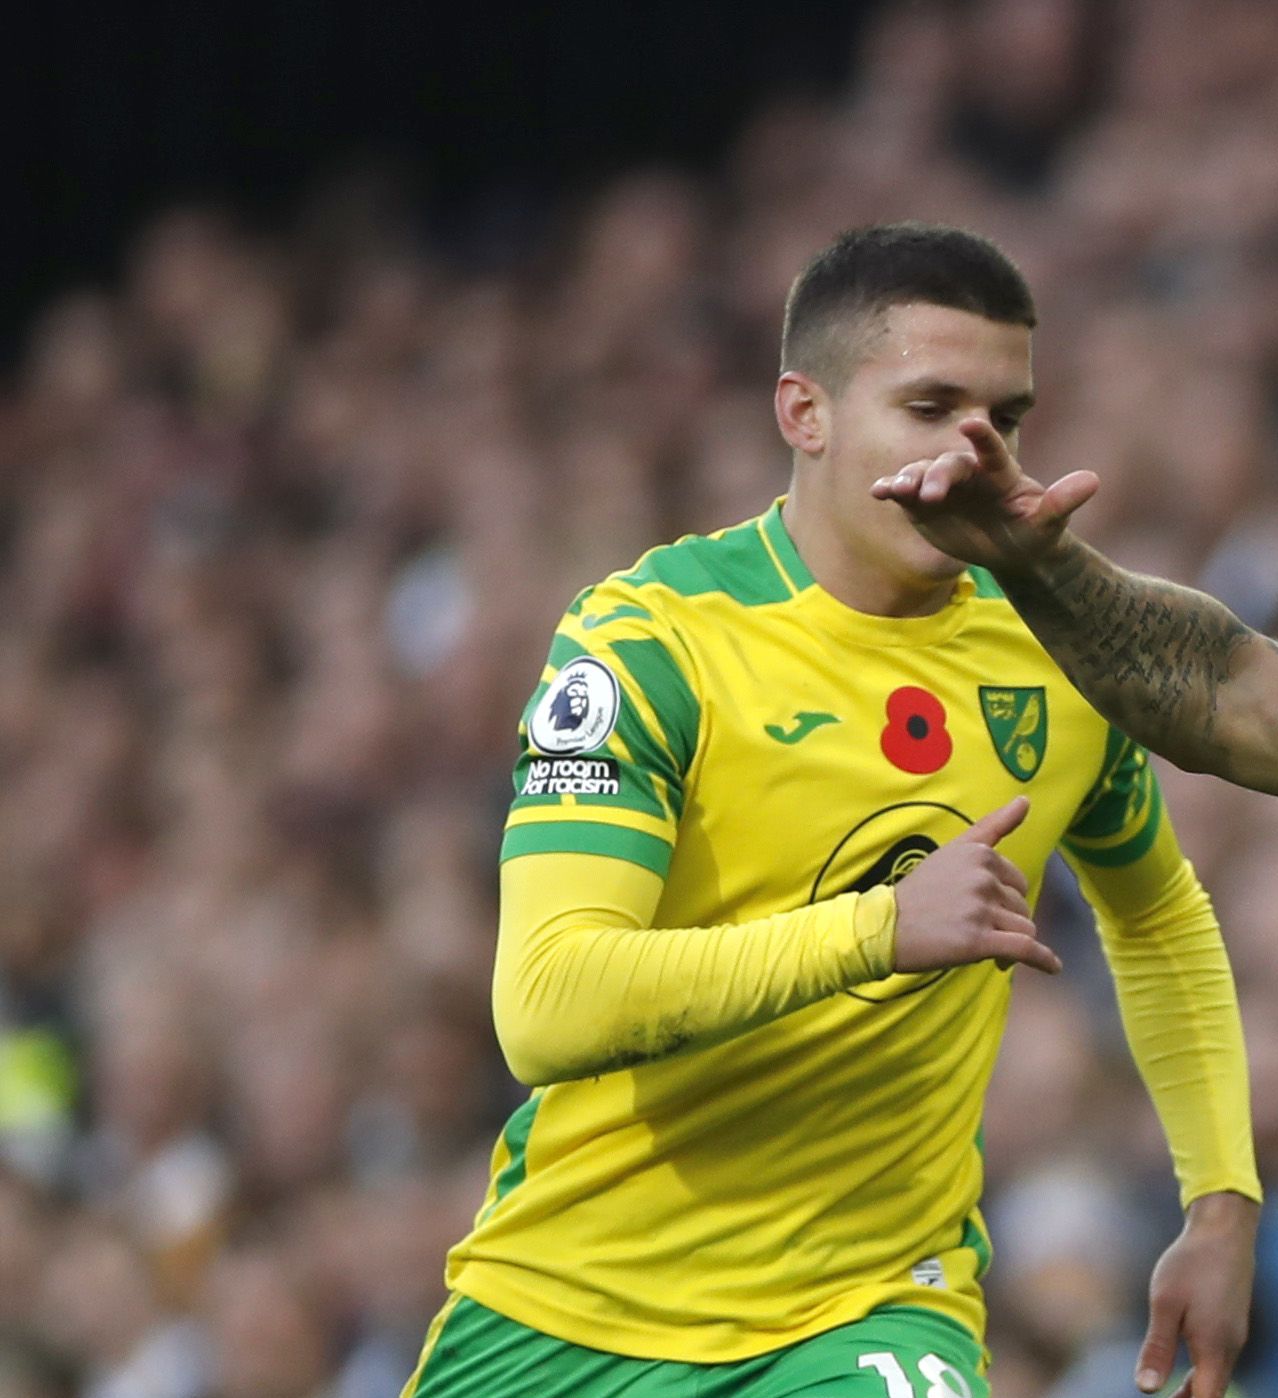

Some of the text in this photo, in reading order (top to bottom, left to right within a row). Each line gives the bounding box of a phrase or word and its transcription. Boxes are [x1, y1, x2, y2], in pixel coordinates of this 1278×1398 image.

[528, 759, 609, 779] No room
[548, 778, 618, 795] racism
